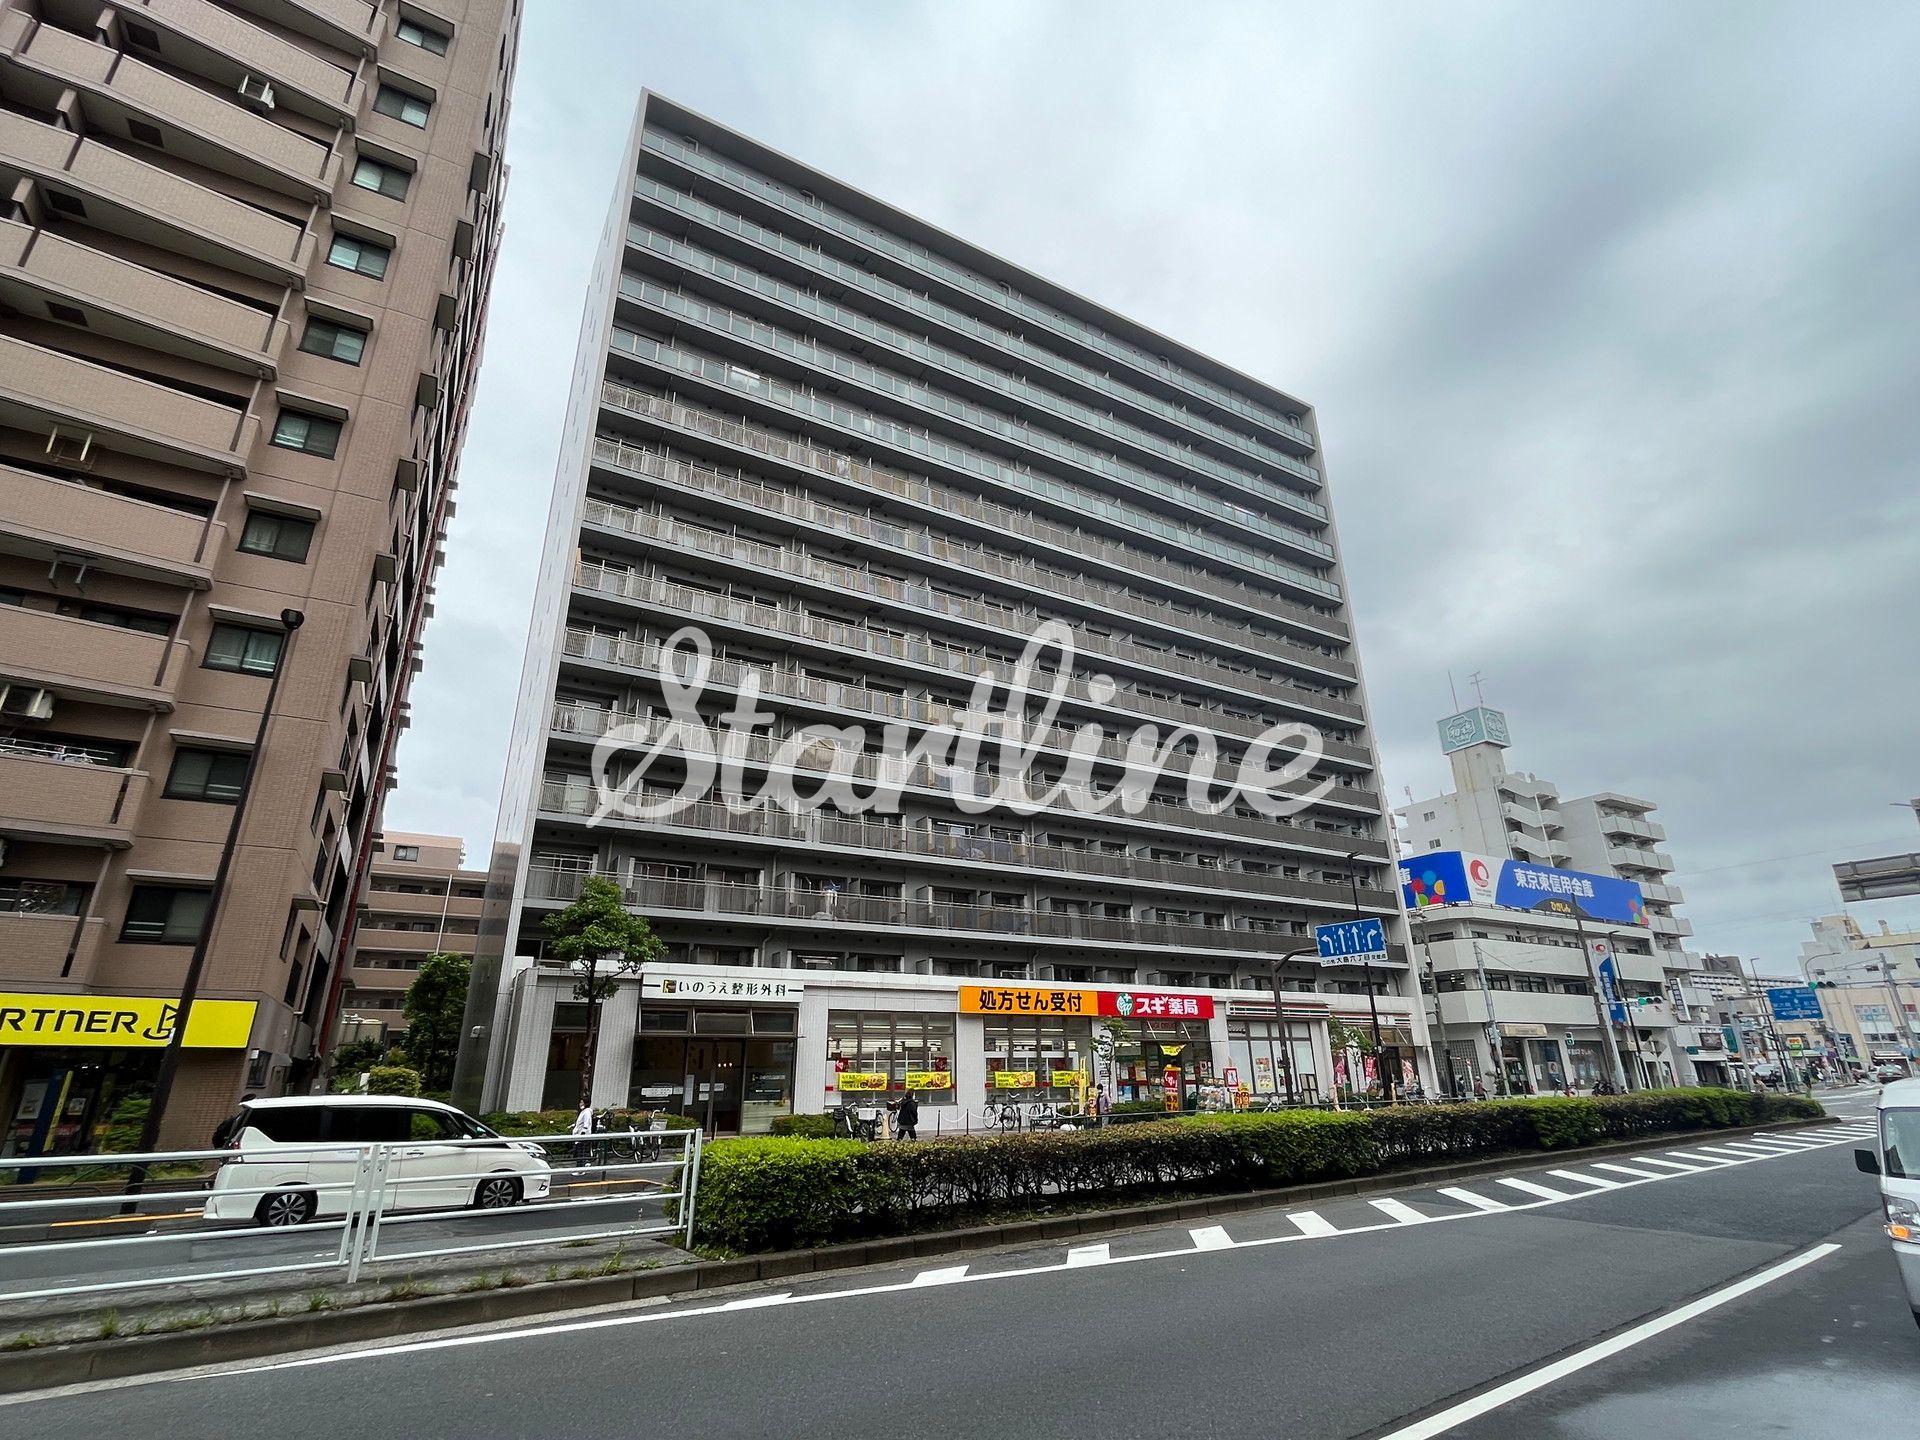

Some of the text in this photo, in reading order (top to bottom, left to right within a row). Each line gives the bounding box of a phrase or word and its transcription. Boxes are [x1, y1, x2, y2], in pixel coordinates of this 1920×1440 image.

[1513, 868, 1595, 898] 東京東信用金庫
[679, 981, 786, 996] いのうえ整形外科
[979, 989, 1082, 1012] 処方せん受付
[1136, 996, 1199, 1015] スギ薬局
